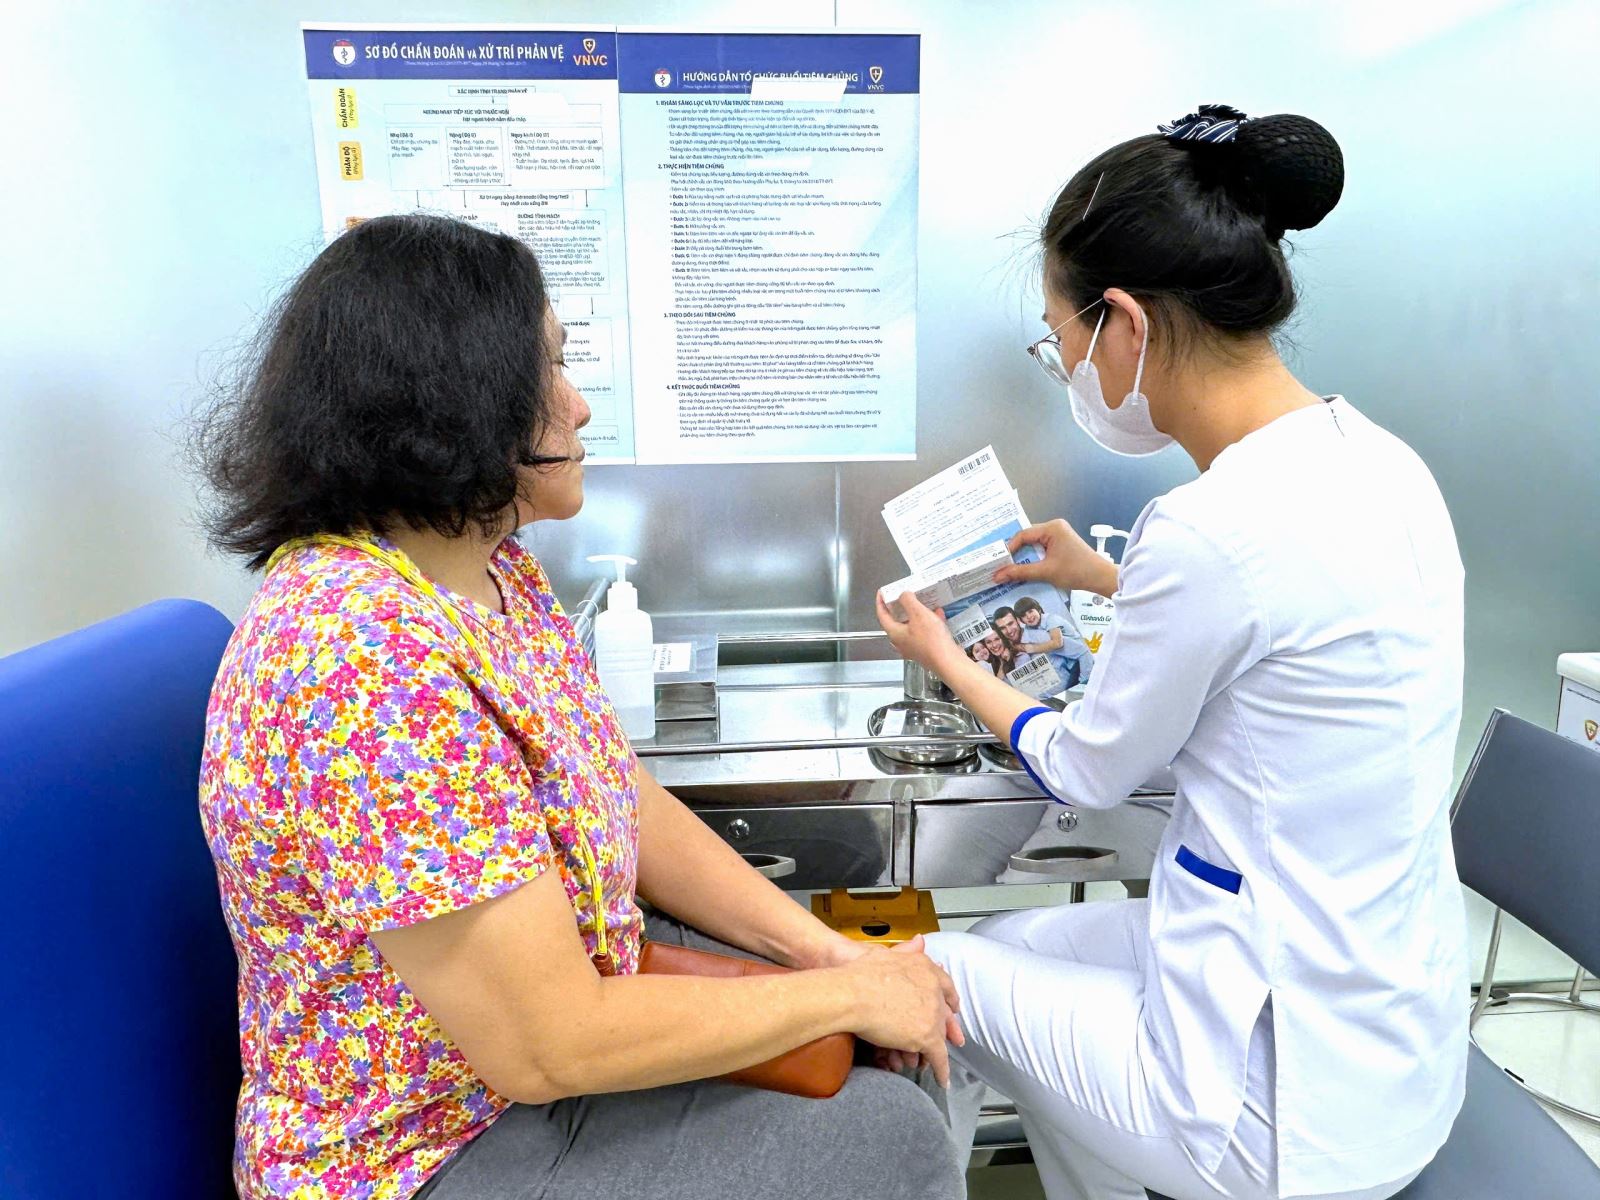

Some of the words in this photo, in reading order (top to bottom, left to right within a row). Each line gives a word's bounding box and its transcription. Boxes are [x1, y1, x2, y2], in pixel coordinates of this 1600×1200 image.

[366, 45, 379, 58] SƠ
[401, 42, 430, 58] CHẨN
[434, 44, 464, 58] ĐOÁN
[467, 49, 477, 58] VÀ
[479, 43, 493, 58] XỬ
[496, 44, 514, 59] TRÍ
[518, 43, 548, 59] PHẢN
[550, 45, 564, 62] VỆ
[573, 55, 607, 65] VNVC
[683, 72, 717, 81] HƯỚNG
[719, 70, 739, 81] DẪN
[741, 70, 751, 81] TỔ
[339, 88, 348, 107] ĐOÁN
[341, 108, 349, 128] CHẨN
[343, 146, 351, 156] ĐỘ
[344, 157, 352, 176] PHÂN
